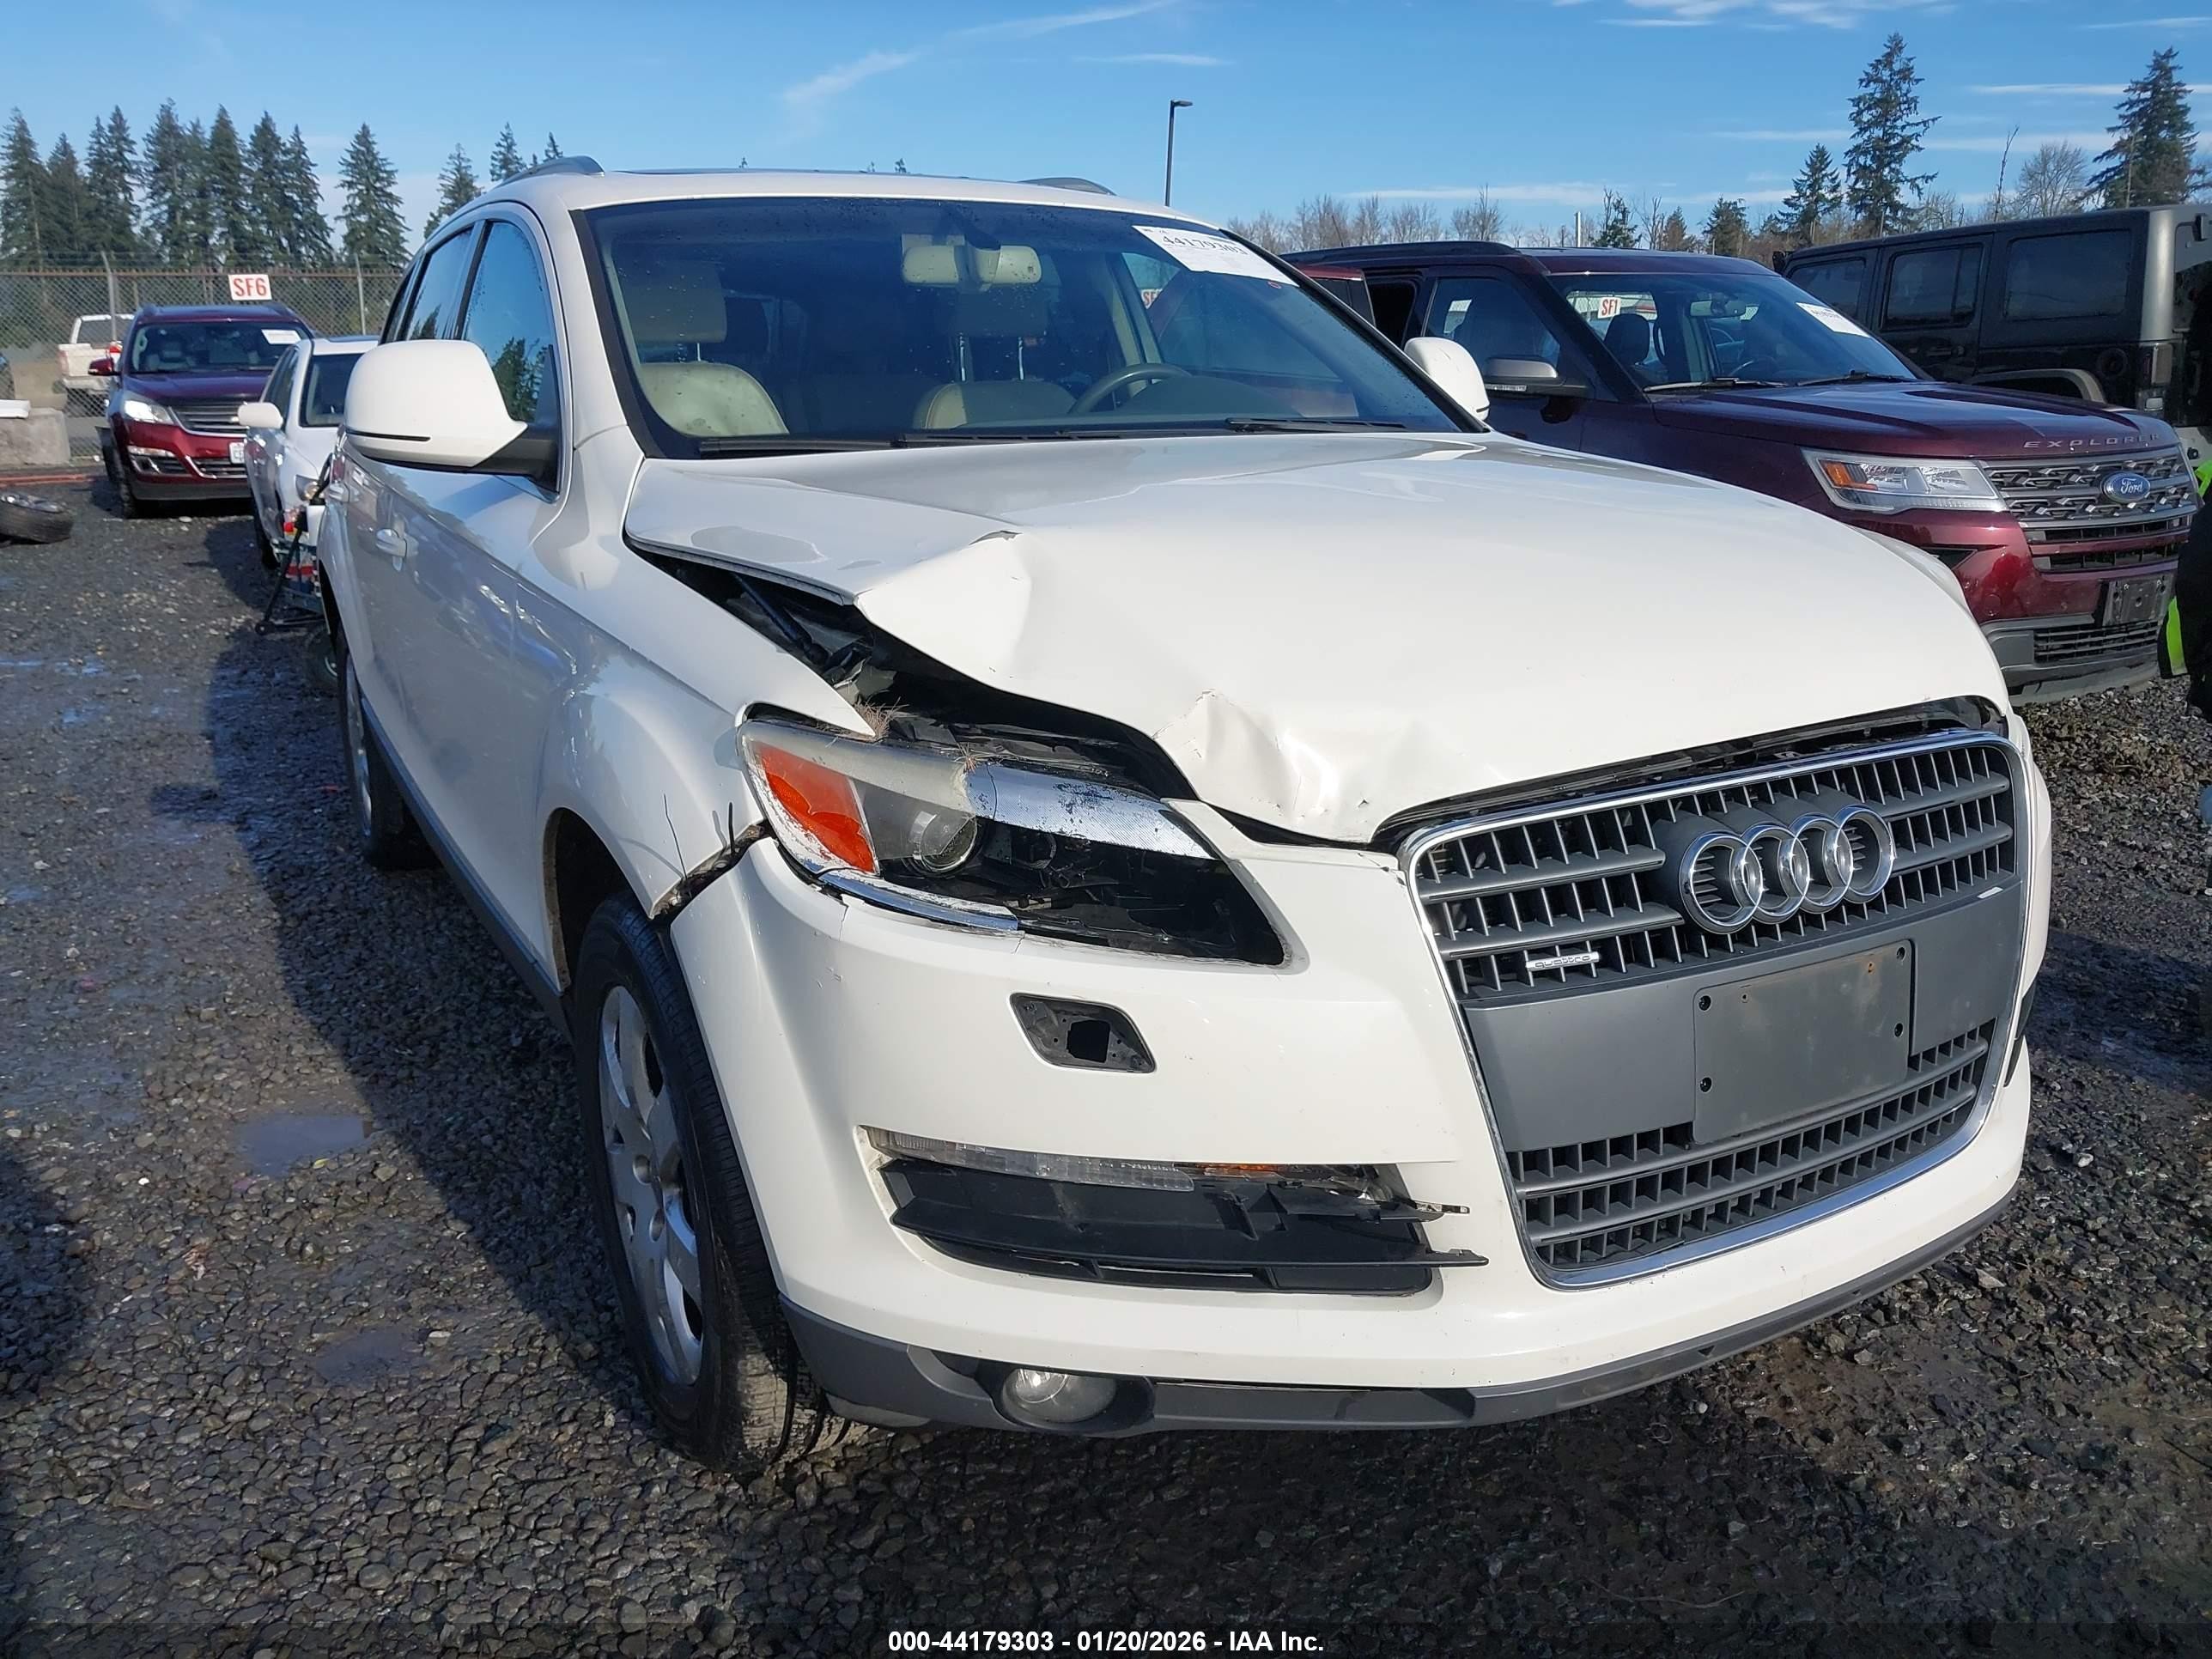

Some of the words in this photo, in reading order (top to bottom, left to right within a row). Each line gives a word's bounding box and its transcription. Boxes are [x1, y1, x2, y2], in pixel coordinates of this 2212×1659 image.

[233, 277, 267, 297] SF6
[1601, 299, 1619, 317] SF1
[2023, 434, 2160, 448] EXPLORER
[2120, 477, 2143, 494] Ford
[1534, 955, 1590, 969] quattro
